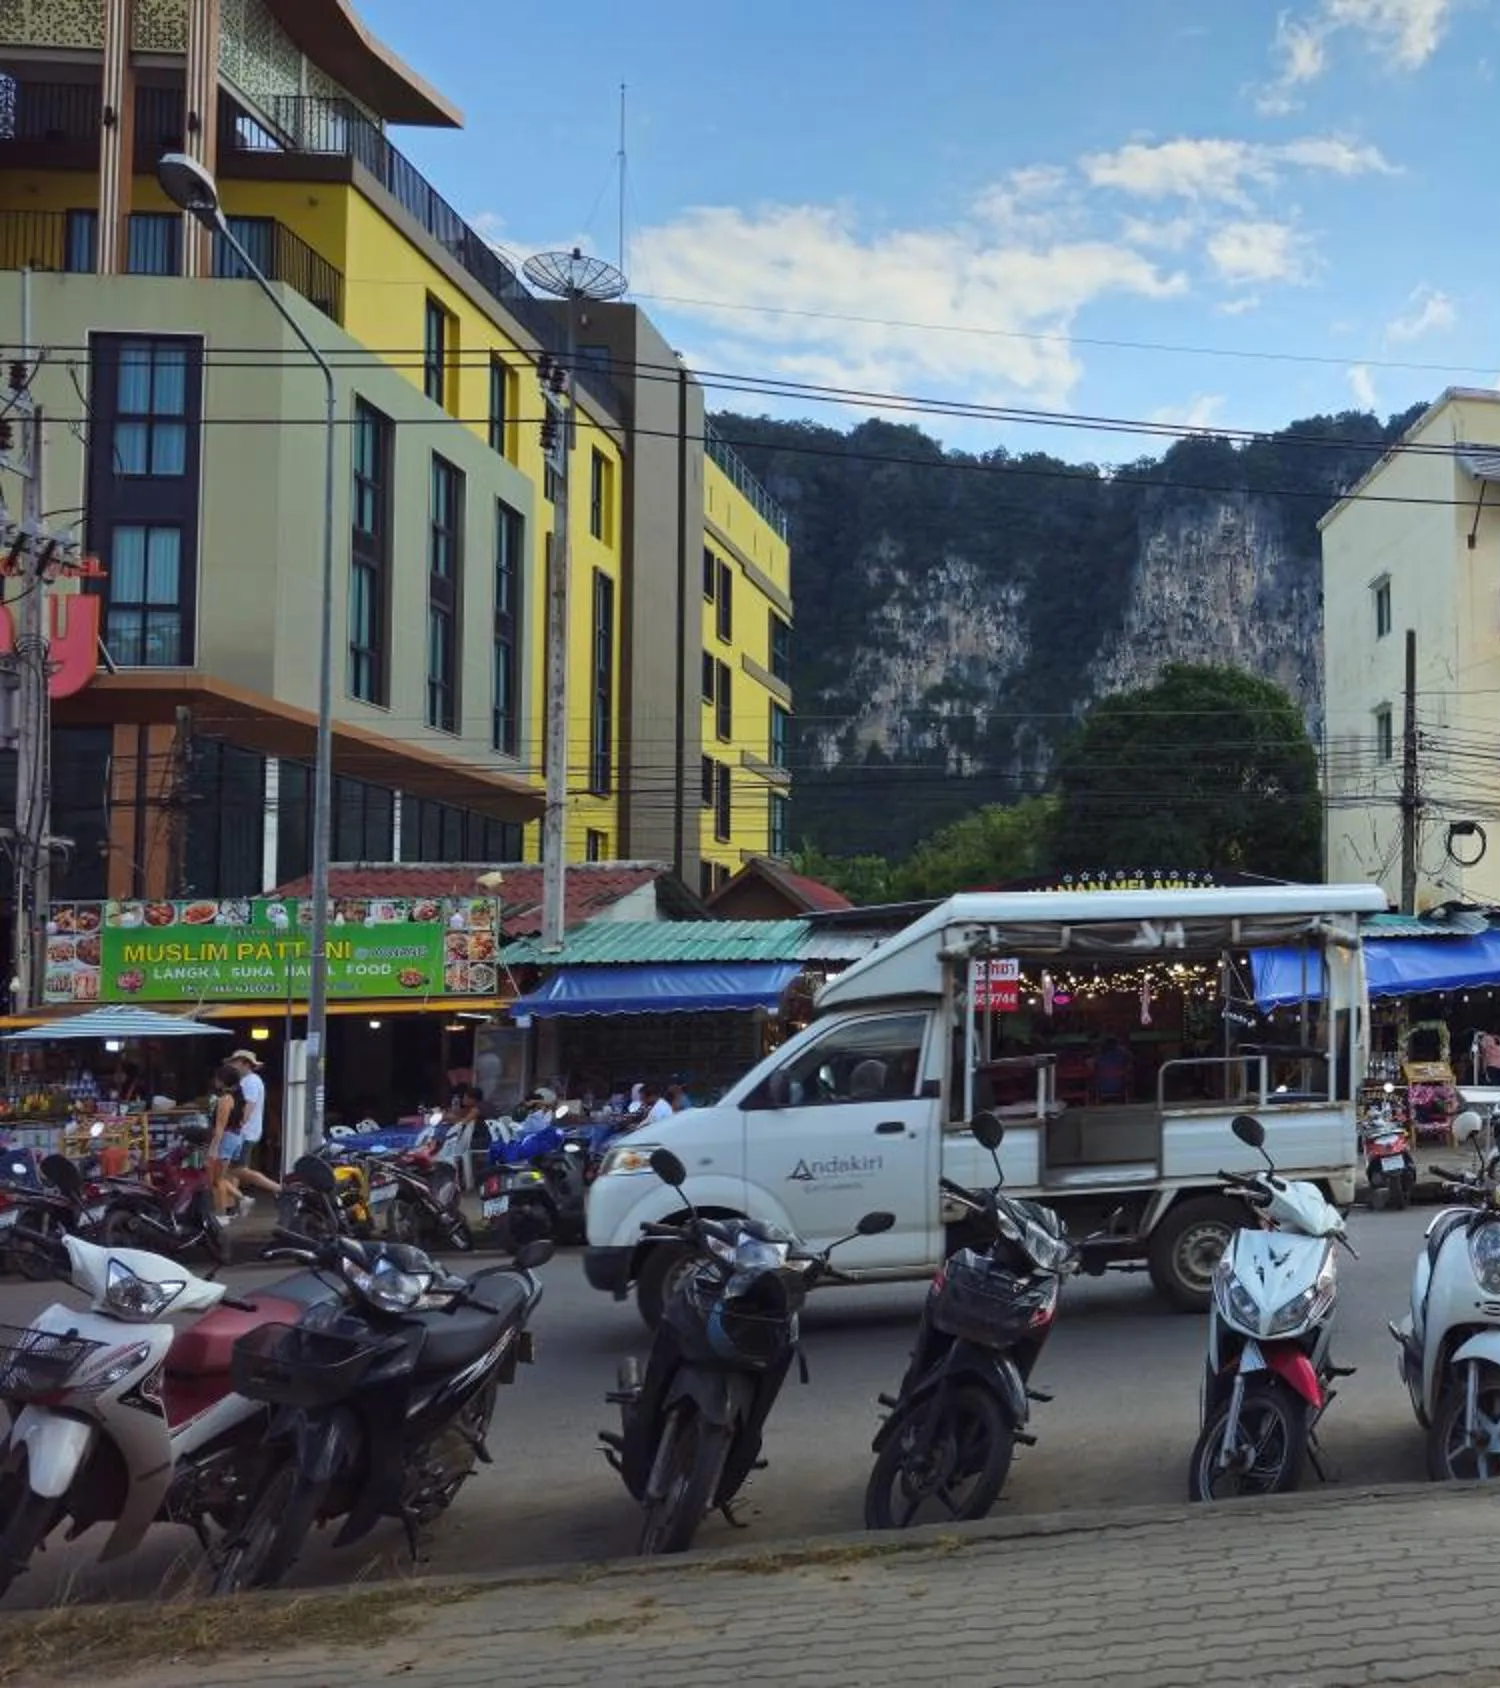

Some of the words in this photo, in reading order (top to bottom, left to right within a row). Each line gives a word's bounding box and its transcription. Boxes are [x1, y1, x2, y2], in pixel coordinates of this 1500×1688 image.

[123, 941, 229, 963] MUSLIM
[236, 939, 351, 961] PATTNI
[153, 966, 219, 980] LANGKA
[231, 965, 275, 977] SUKA
[346, 963, 393, 975] FOOD
[786, 1155, 883, 1181] Andakiri
